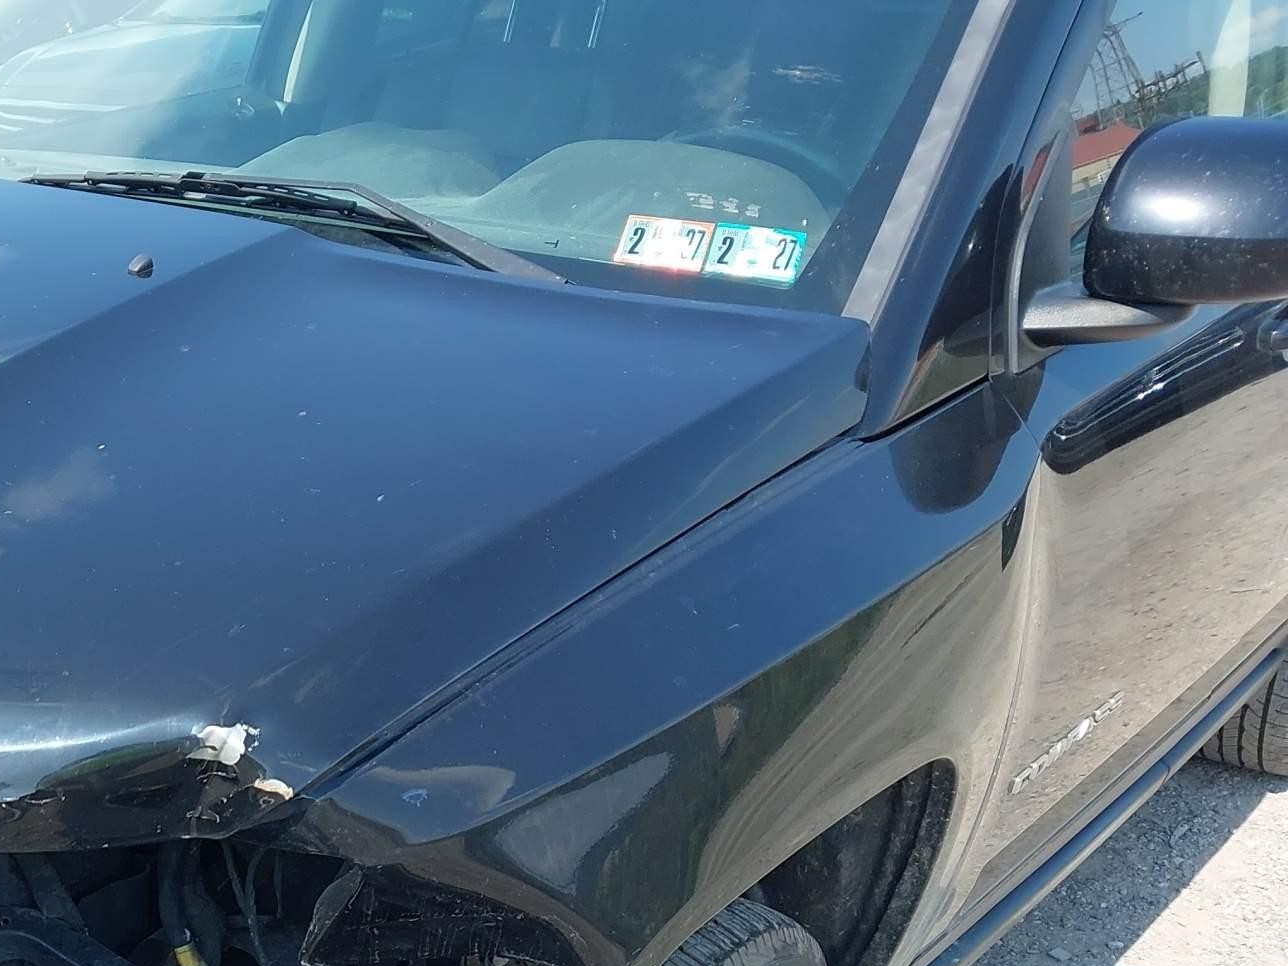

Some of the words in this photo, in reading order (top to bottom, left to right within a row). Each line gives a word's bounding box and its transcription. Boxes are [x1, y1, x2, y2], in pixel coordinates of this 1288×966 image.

[627, 227, 646, 255] 2
[716, 236, 735, 265] 2
[772, 237, 799, 271] 27
